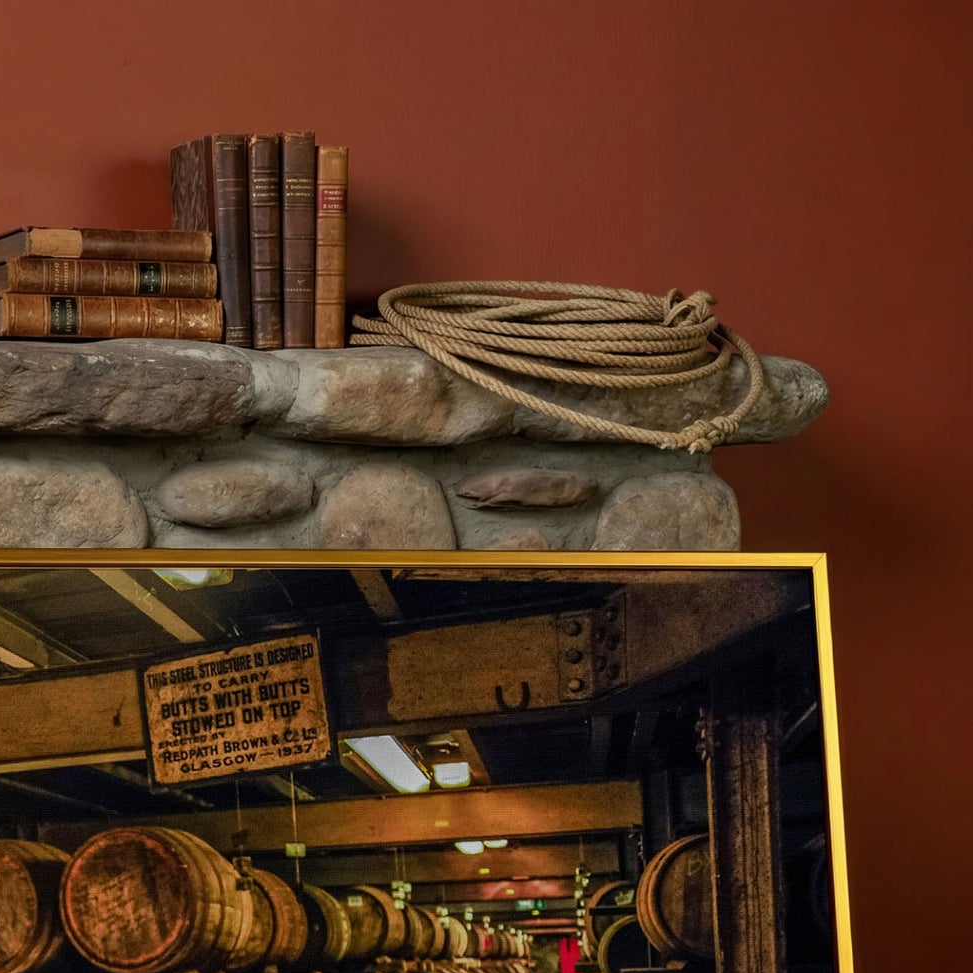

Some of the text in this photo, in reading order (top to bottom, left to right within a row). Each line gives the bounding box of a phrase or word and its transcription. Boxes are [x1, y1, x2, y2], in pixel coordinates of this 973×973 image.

[147, 643, 314, 689] THIS STEEL STRUCTURE IS DESIGNED
[193, 671, 269, 693] TO CARRY
[161, 678, 310, 719] BUTTS WITH BUTTS
[172, 701, 301, 737] STOWED ON TOP
[158, 731, 226, 749] ERECTED BY
[163, 745, 219, 763] REDPATH
[223, 736, 268, 754] BROWN
[271, 733, 280, 746] &
[180, 752, 257, 773] GLASGOW
